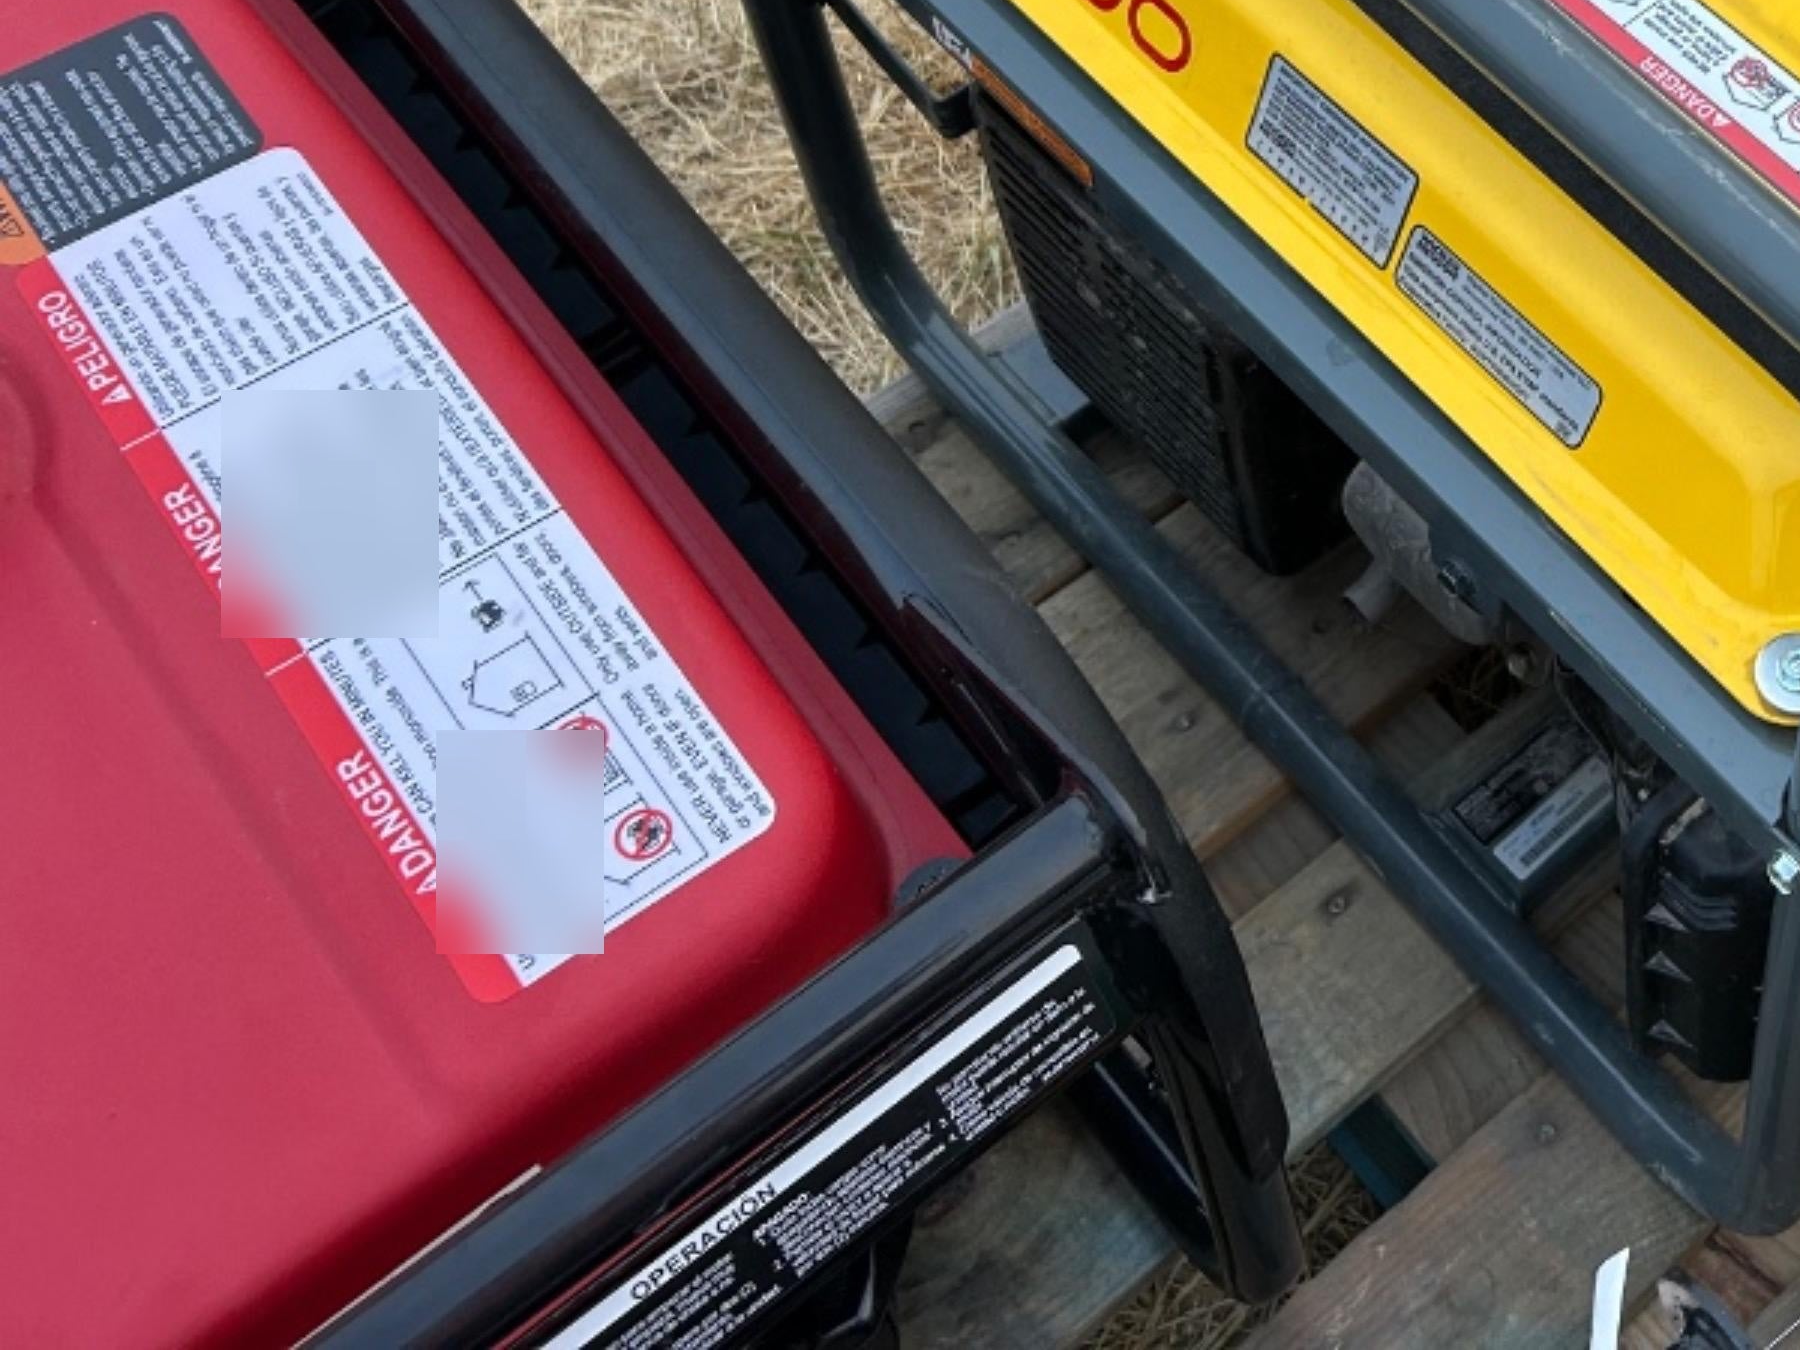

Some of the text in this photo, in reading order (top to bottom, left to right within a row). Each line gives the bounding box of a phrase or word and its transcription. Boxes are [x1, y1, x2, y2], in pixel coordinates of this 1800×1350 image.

[34, 285, 120, 393] PELIGRO
[338, 748, 437, 883] DANGER
[622, 1176, 784, 1307] OPERACIÓN
